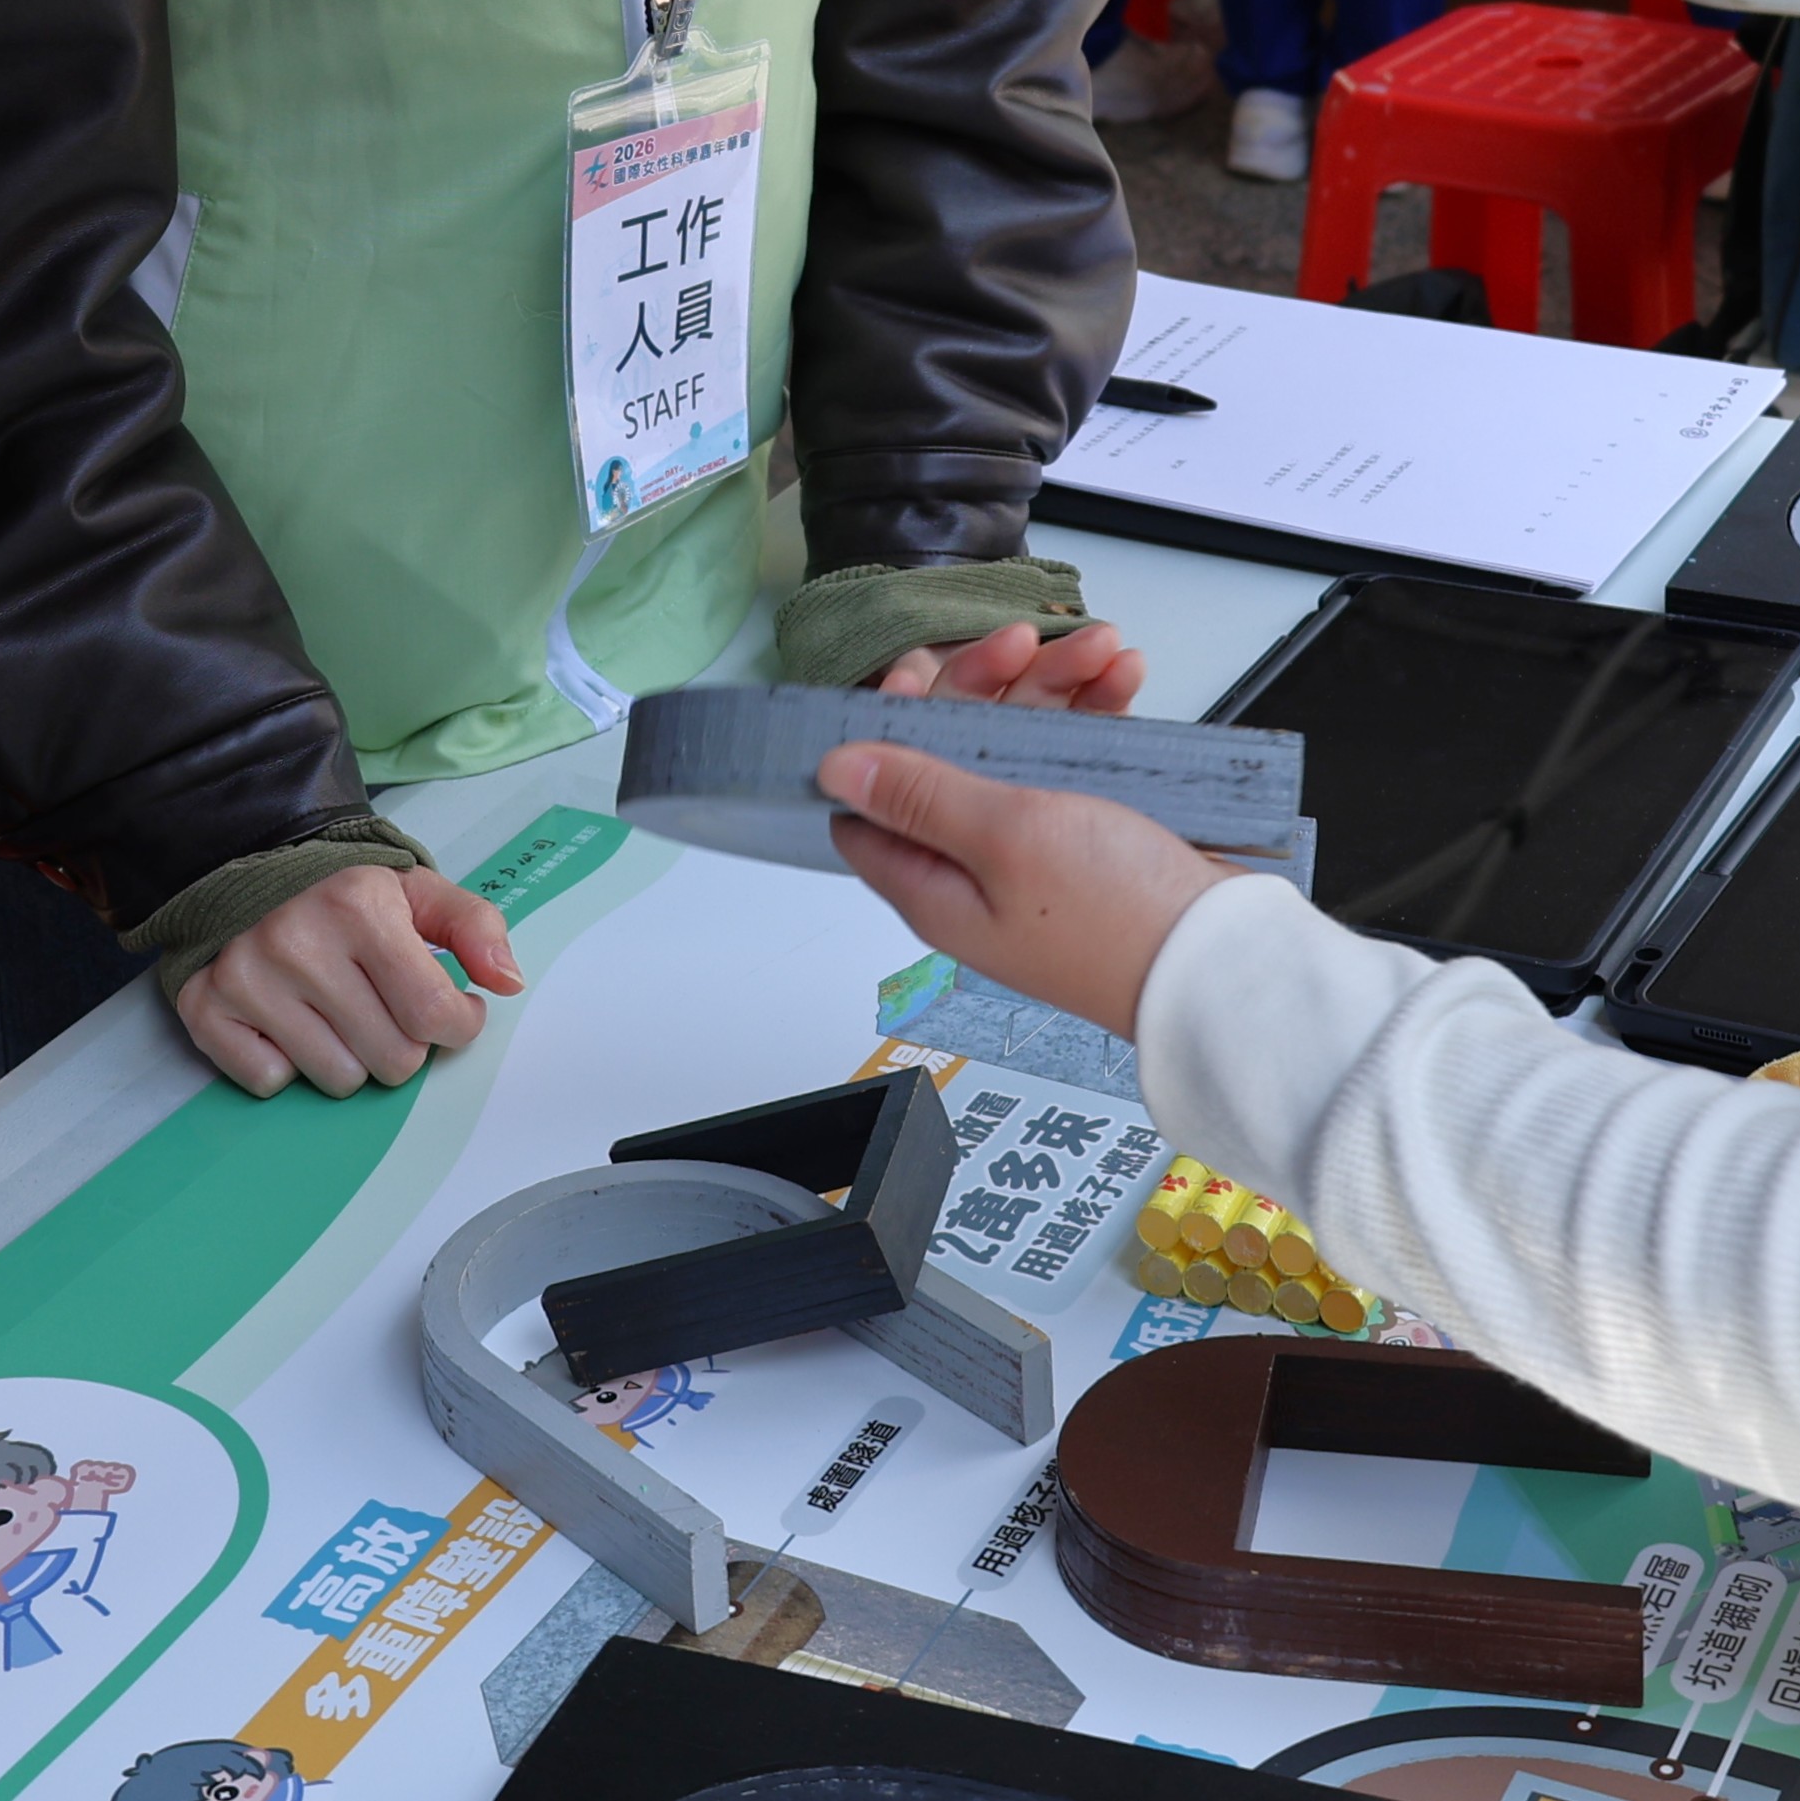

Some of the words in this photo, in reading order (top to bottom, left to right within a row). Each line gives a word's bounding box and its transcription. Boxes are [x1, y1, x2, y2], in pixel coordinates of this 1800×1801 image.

[612, 131, 751, 185] 國際女性科學嘉年華會
[613, 137, 656, 164] 2026
[617, 195, 724, 283] 工作
[615, 279, 714, 373] 人員
[623, 372, 705, 440] STAFF
[697, 455, 728, 476] SCIENCE
[479, 839, 556, 903] 電力公司
[926, 1105, 1112, 1266] 2萬多束
[1010, 1124, 1161, 1282] 用過核子燃料
[806, 1419, 902, 1513] 處置隧道
[288, 1517, 431, 1624] 高放
[304, 1498, 545, 1722] 多重障壁設
